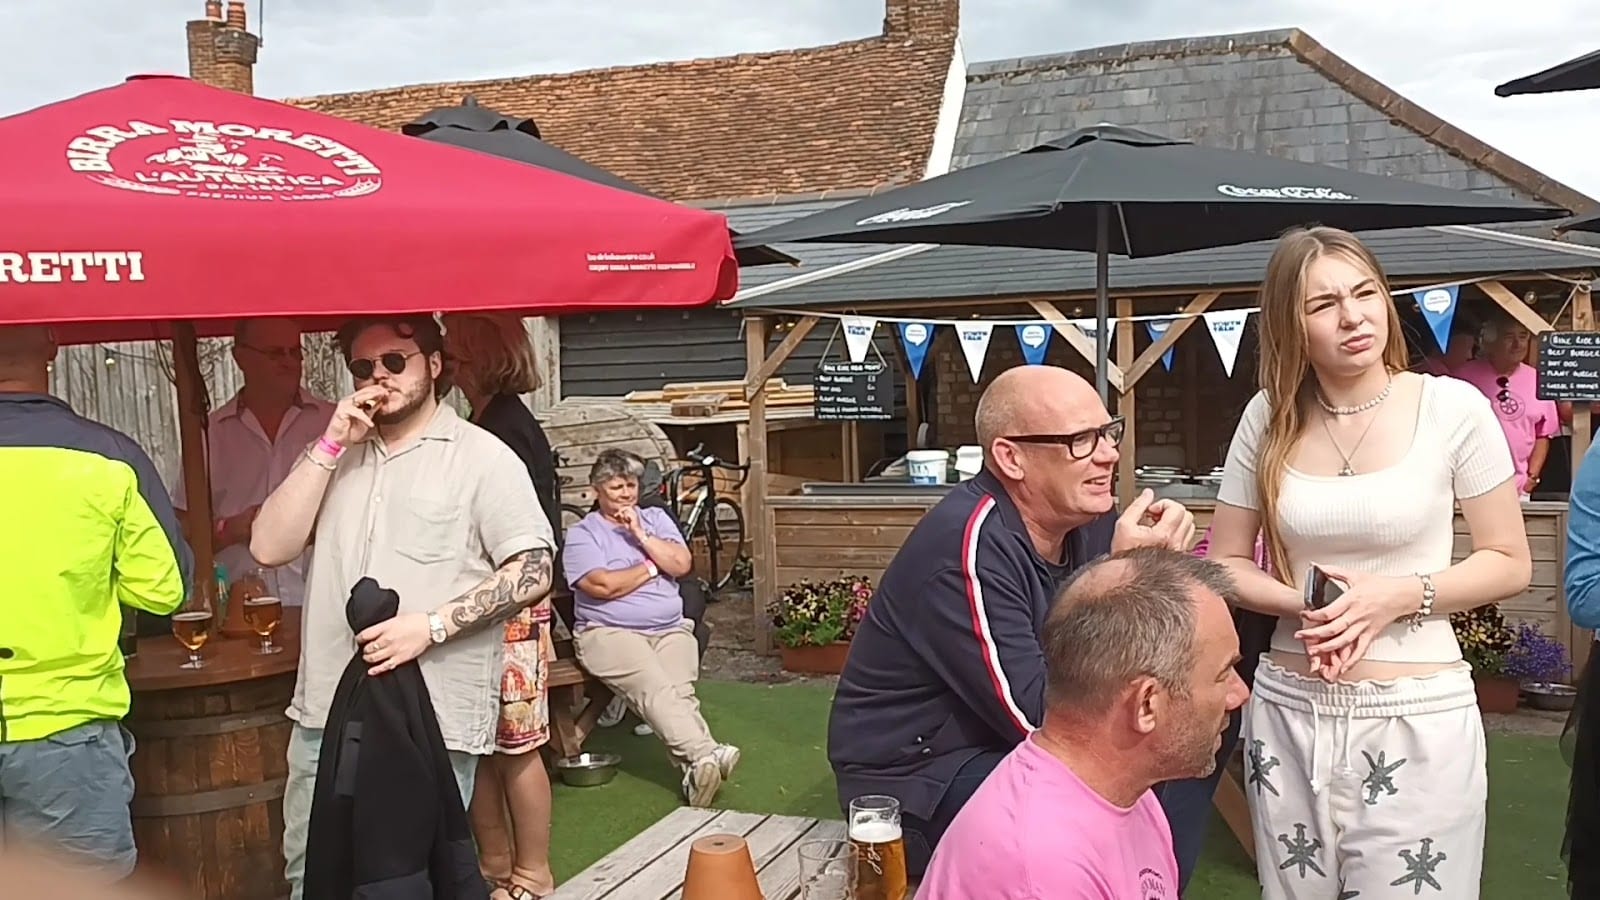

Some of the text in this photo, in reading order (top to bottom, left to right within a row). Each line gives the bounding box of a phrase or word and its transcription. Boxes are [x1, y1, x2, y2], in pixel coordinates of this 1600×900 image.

[66, 119, 381, 175] BIRRA MORETTI
[135, 171, 344, 186] L'AUTENTICA
[0, 251, 145, 283] RETTI
